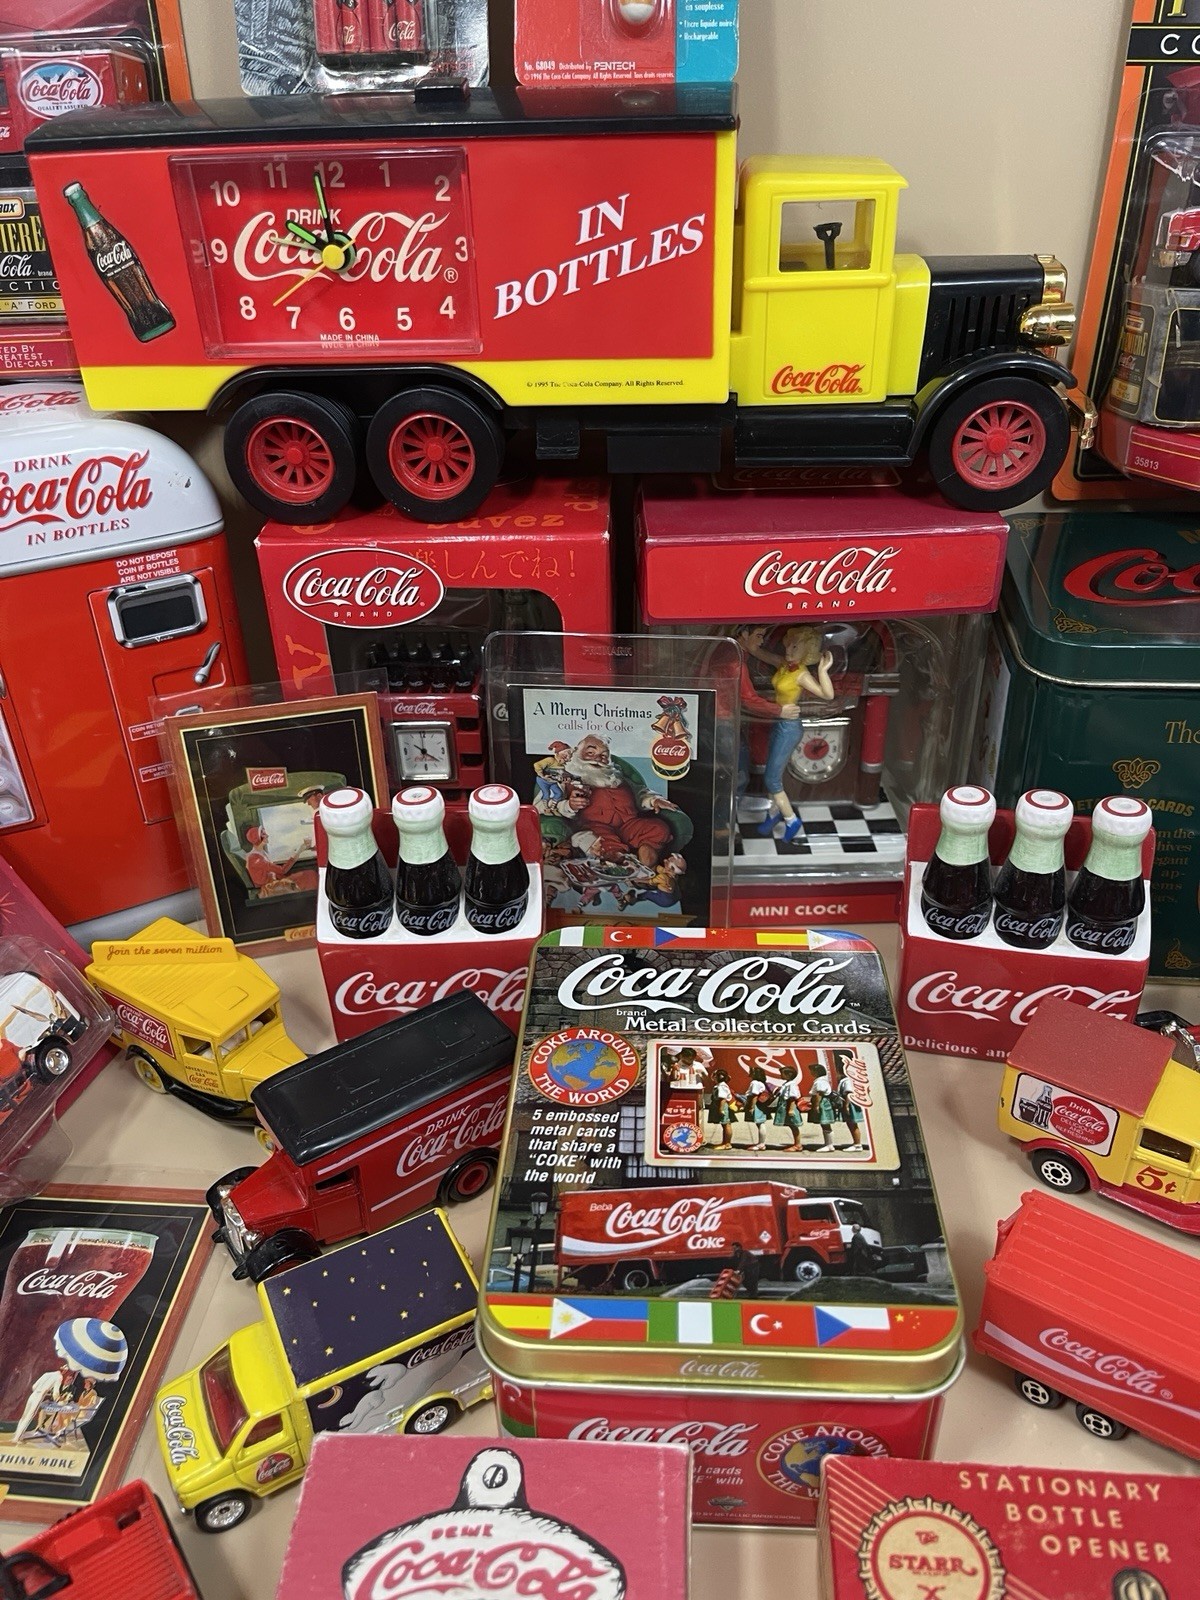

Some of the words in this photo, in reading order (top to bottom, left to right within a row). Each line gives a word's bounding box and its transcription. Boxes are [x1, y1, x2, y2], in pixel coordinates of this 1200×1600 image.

[535, 60, 555, 71] 68049
[594, 61, 635, 70] PENTECH
[25, 74, 93, 102] Coca-Cola
[263, 162, 288, 188] 11
[314, 161, 346, 188] 12
[378, 162, 391, 188] 1
[210, 180, 241, 207] 10
[434, 175, 452, 202] 2
[575, 193, 631, 246] IN
[210, 238, 229, 264] 9
[454, 236, 469, 262] 3
[493, 213, 706, 320] BOTTLES
[28, 301, 57, 310] FORD
[239, 296, 257, 321] 8
[439, 295, 456, 320] 4
[286, 306, 301, 330] 7
[339, 307, 356, 331] 6
[396, 307, 413, 331] 5
[320, 333, 343, 342] MADE
[345, 333, 352, 342] IN
[355, 333, 380, 342] CHINA
[636, 380, 655, 389] Rights
[771, 364, 866, 395] Coca-Cola
[14, 453, 73, 473] DRINK
[1134, 456, 1160, 471] 35813
[0, 449, 153, 532] oca-Cola
[27, 532, 46, 546] IN
[53, 518, 131, 542] BOTTLES
[116, 559, 128, 567] DO
[129, 556, 145, 566] NOT
[146, 550, 178, 564] DEPOSIT
[118, 566, 137, 576] COIN
[138, 564, 145, 572] IF
[146, 558, 180, 571] BOTTLES
[120, 575, 136, 584] ARE
[137, 572, 153, 581] NOT
[153, 566, 181, 578] VISIBLE
[744, 546, 903, 598] Coca-Cola
[294, 567, 423, 607] Coca-Cola
[786, 600, 856, 609] BRAND
[394, 702, 438, 715] Coca-Cola
[533, 702, 546, 716] A
[550, 703, 588, 720] Merry
[594, 703, 652, 719] Christmas
[558, 720, 583, 731] calls
[586, 719, 603, 731] for
[606, 720, 634, 732] Coke
[653, 744, 686, 757] Coca-Cola
[252, 773, 285, 786] Coca-Cola
[1147, 799, 1195, 817] CARDS
[332, 907, 392, 933] Coca-Cola
[399, 905, 459, 931] Coca-Cola
[467, 902, 525, 928] Coca-Cola
[750, 905, 789, 917] MINI
[795, 904, 848, 916] CLOCK
[924, 907, 987, 934] Coca-Cola
[995, 913, 1060, 939] Coca-Cola
[1068, 922, 1136, 948] Coca-Cola
[107, 945, 130, 961] Join
[134, 946, 150, 955] the
[152, 947, 183, 955] seven
[186, 945, 223, 954] million
[557, 953, 854, 1015] Coca-Cola
[117, 1004, 168, 1044] Coca-Cola
[616, 1009, 647, 1017] brand
[624, 1016, 687, 1033] Metal
[694, 1018, 796, 1034] Collector
[803, 1019, 872, 1035] Cards
[533, 1032, 572, 1065] COKE
[575, 1029, 637, 1067] AROUND
[904, 1035, 978, 1055] Delicious
[189, 1074, 219, 1089] Coca-Cola
[535, 1073, 565, 1100] THE
[568, 1078, 630, 1105] WORLD
[839, 1054, 874, 1108] Coca-Cola
[532, 1109, 543, 1121] 5
[545, 1109, 620, 1124] embossed
[1054, 1105, 1106, 1132] Coca-Cola
[1069, 1101, 1092, 1115] Drink
[424, 1104, 471, 1138] DRINK
[530, 1125, 573, 1136] metal
[576, 1126, 617, 1138] cards
[1060, 1117, 1095, 1135] DELICIOUS
[1069, 1126, 1084, 1135] AND
[396, 1094, 509, 1178] Coca-Cola
[528, 1139, 559, 1151] that
[561, 1140, 603, 1152] share
[606, 1143, 616, 1153] a
[1055, 1125, 1096, 1145] REFRESHING
[590, 1156, 622, 1169] with
[524, 1169, 549, 1182] the
[553, 1171, 597, 1184] world
[1135, 1165, 1178, 1194] 5¢
[605, 1196, 725, 1239] Coca-Cola
[687, 1233, 726, 1251] Coke
[17, 1268, 128, 1299] Coca-Cola
[407, 1324, 475, 1370] Coca-Cola
[680, 1359, 763, 1379] Coca-Cola
[1038, 1327, 1165, 1394] Coca-Cola
[160, 1395, 199, 1468] Coca-Cola
[763, 1428, 809, 1462] COKE
[40, 1457, 75, 1469] MORE
[256, 1459, 293, 1483] Coca-Cola
[706, 1466, 742, 1475] cards
[716, 1475, 744, 1485] with
[768, 1470, 802, 1494] THE
[959, 1470, 1161, 1503] STATIONARY
[1005, 1503, 1124, 1530] BOTTLE
[1040, 1534, 1172, 1565] OPENER
[889, 1554, 978, 1577] STARR
